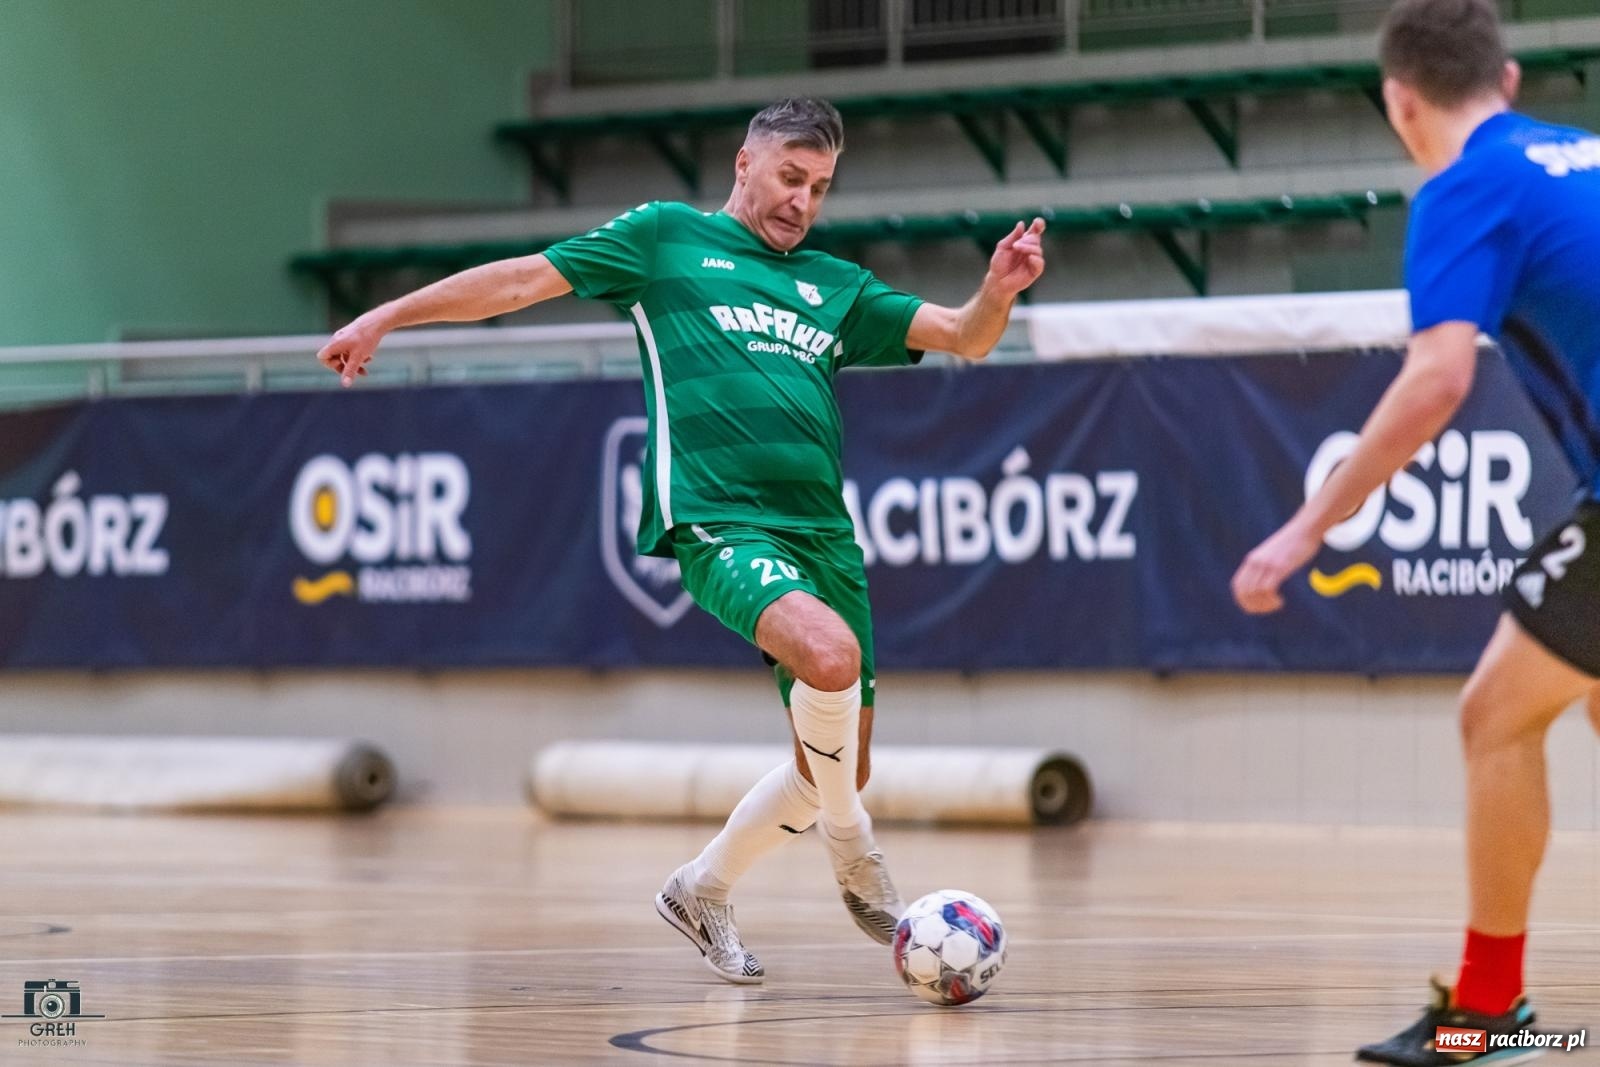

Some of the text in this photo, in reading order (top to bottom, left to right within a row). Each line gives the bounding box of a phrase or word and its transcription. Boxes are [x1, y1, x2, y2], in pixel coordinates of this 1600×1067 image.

[701, 257, 735, 270] JAKO
[709, 302, 834, 356] RAFAKO
[747, 341, 791, 355] GRUPA
[1392, 548, 1528, 596] RACIBÓR
